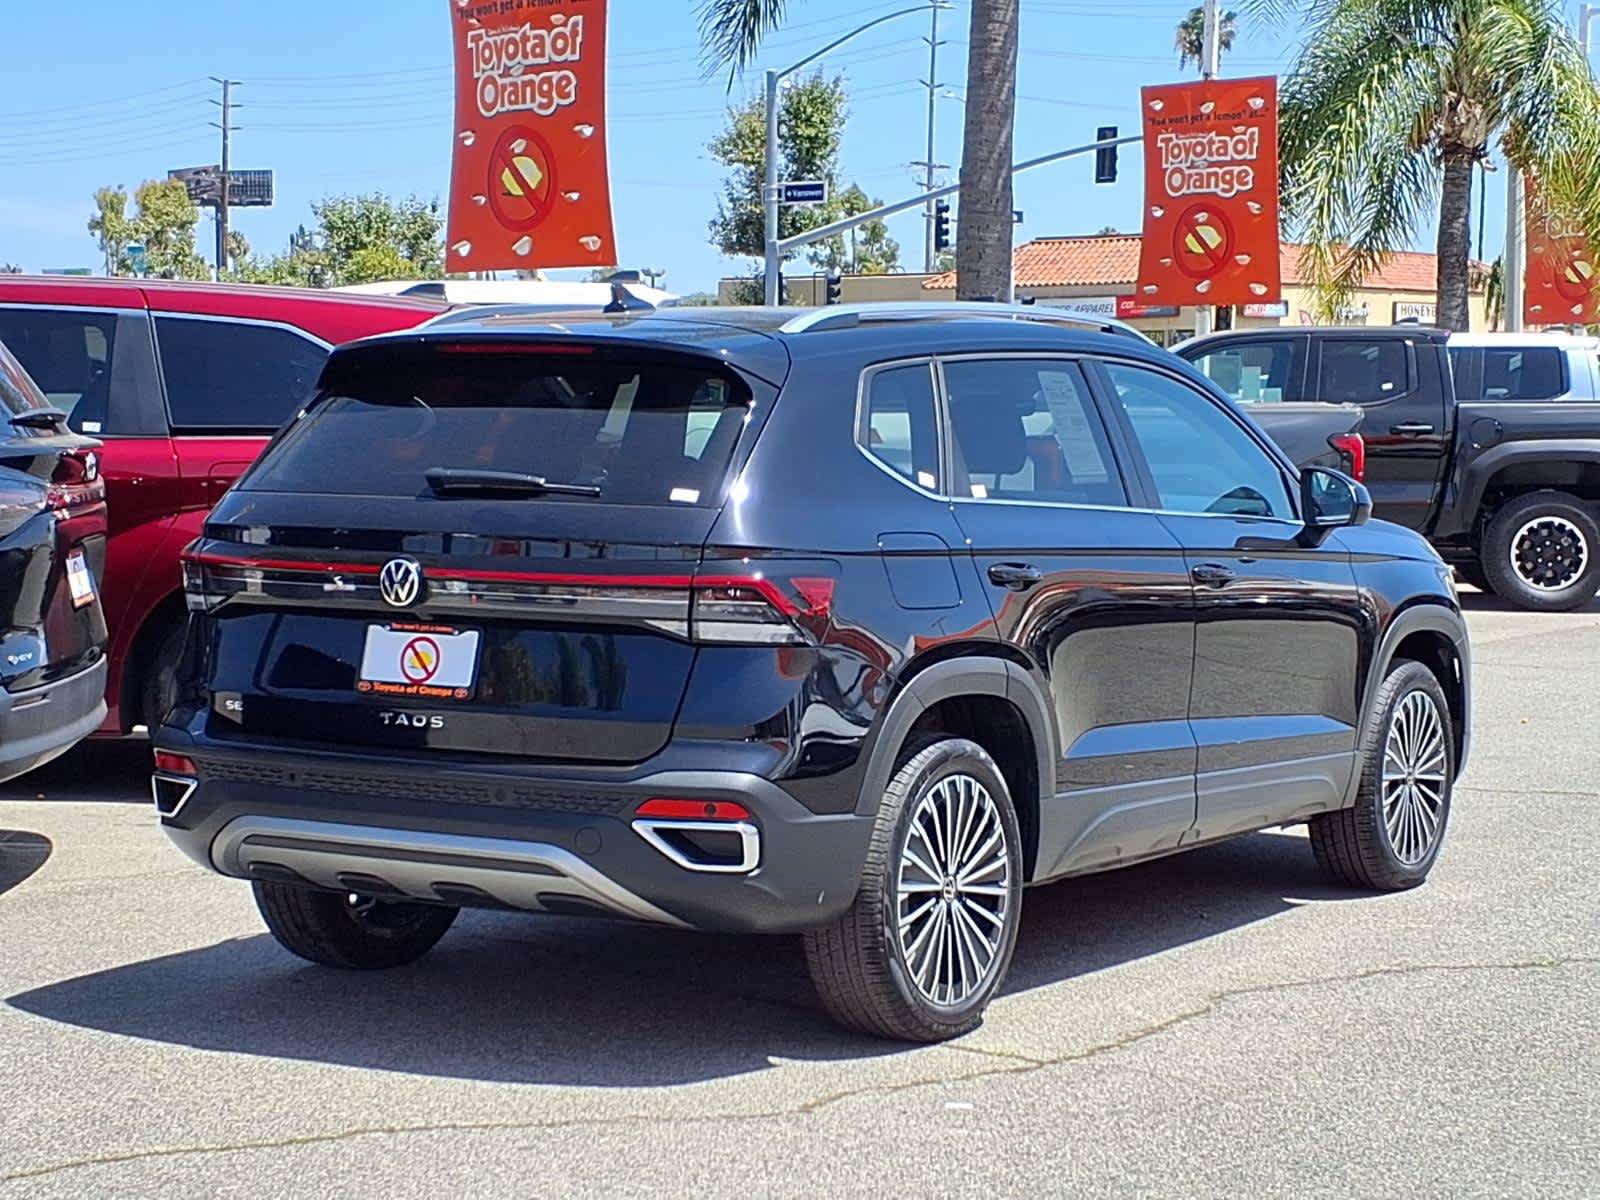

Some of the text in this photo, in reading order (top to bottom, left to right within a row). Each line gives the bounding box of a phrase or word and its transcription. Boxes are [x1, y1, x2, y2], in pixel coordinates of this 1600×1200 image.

[468, 15, 583, 78] Toyota of
[477, 69, 577, 118] Orange
[1158, 126, 1260, 169] Toyota of
[1165, 165, 1255, 198] Orange
[1074, 302, 1115, 314] APPAREL
[225, 698, 244, 712] SE
[379, 712, 445, 729] TAOS
